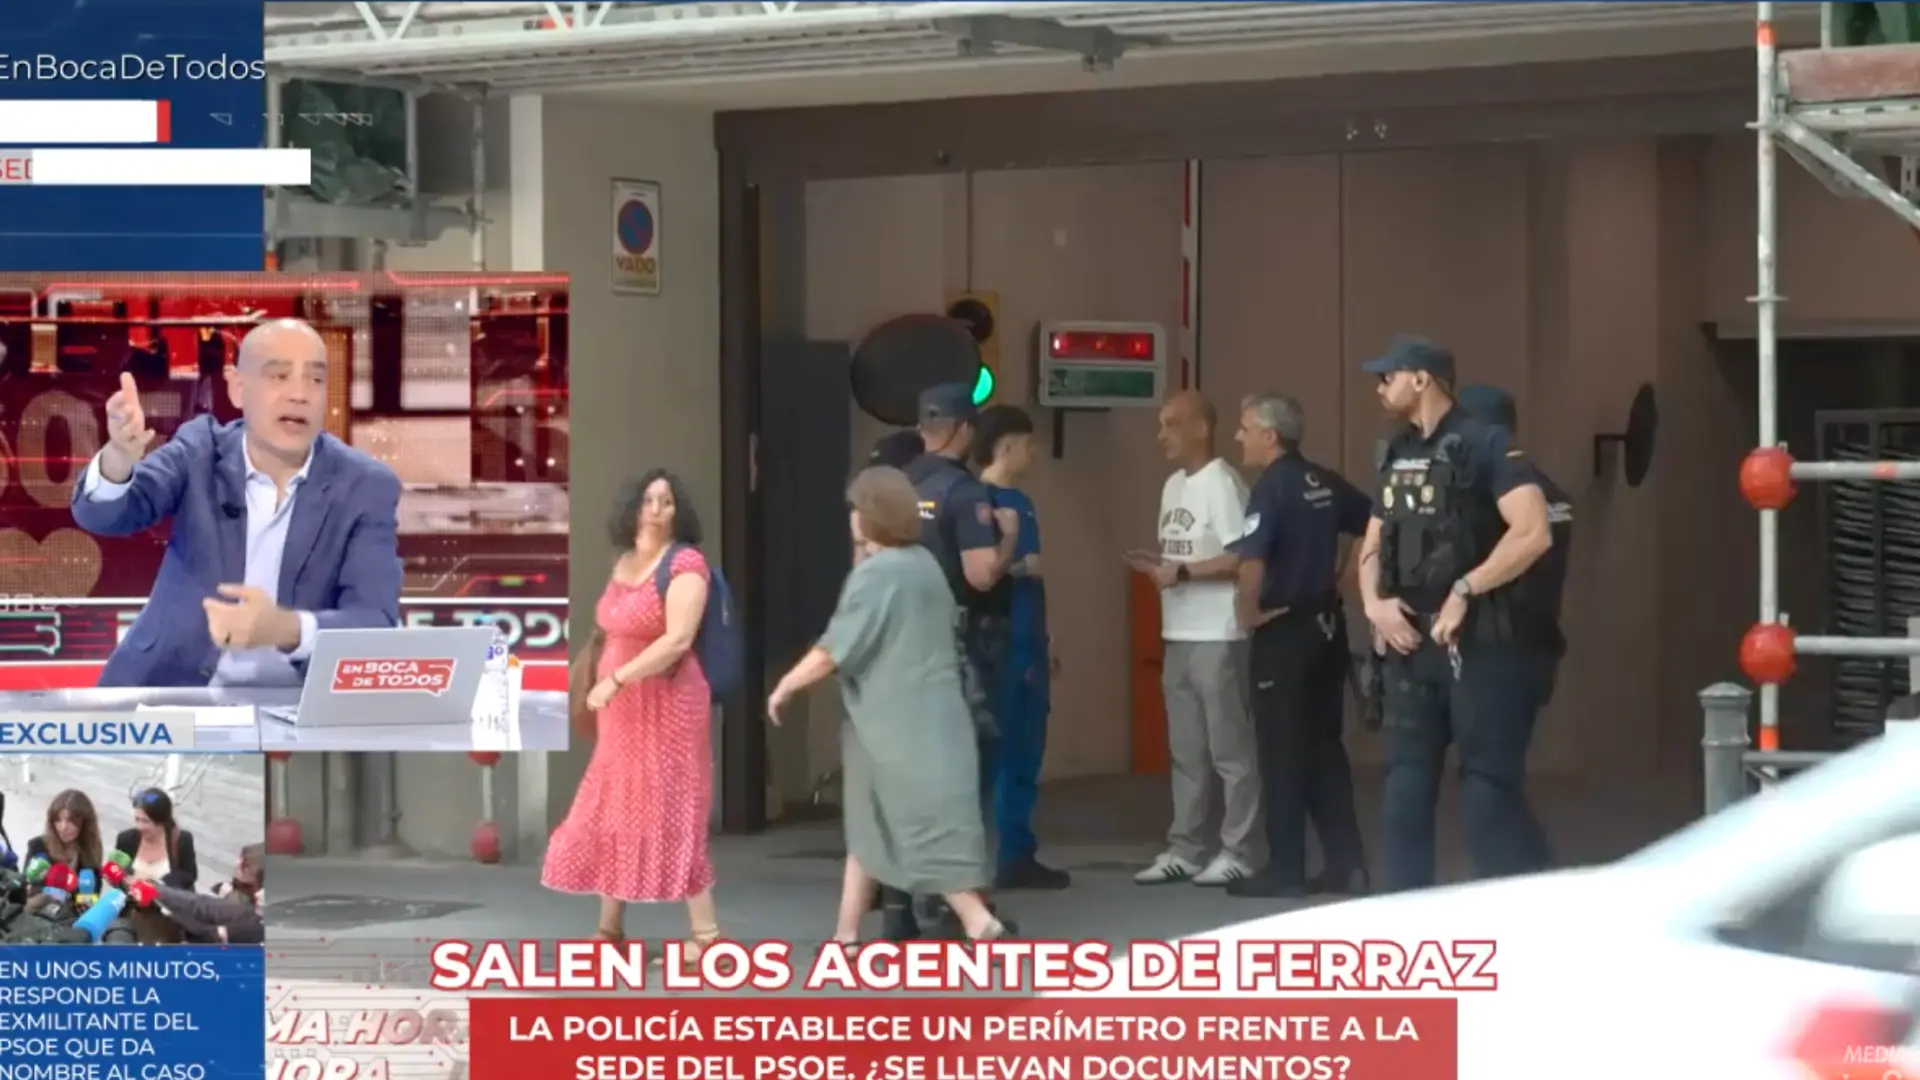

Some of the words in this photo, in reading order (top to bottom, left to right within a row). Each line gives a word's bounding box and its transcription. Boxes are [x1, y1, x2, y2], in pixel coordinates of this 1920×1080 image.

[364, 662, 419, 674] BOCA
[352, 677, 373, 687] DE
[376, 674, 444, 687] TODOS
